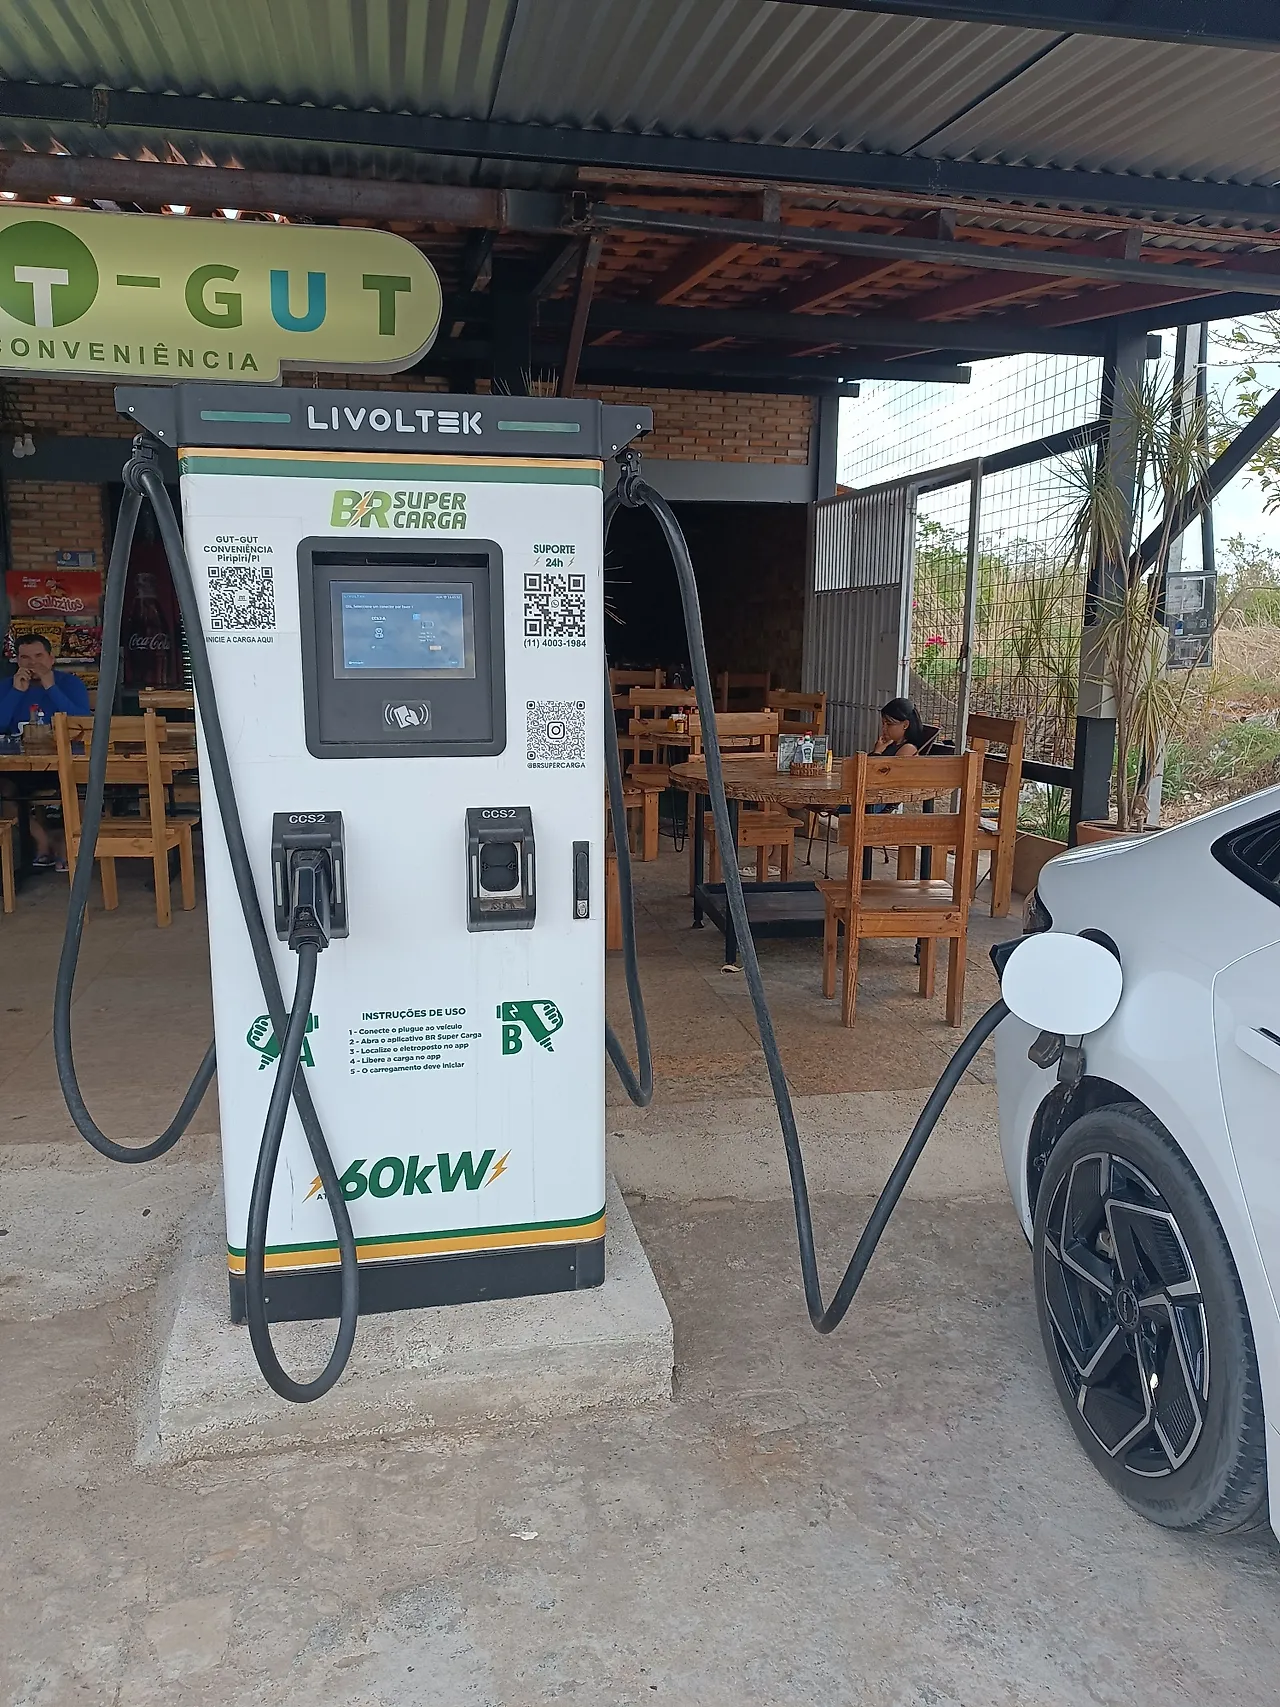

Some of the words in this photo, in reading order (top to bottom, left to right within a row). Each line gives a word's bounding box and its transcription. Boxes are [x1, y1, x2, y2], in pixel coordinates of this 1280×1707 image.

[0, 337, 259, 371] ONVENIÊNCIA
[307, 405, 484, 435] LIVOLTEK
[393, 490, 467, 511] SUPER
[330, 489, 393, 530] BR
[392, 511, 468, 530] CARGA
[215, 535, 259, 544] GUT-GUT
[203, 544, 274, 554] CONVENIÊNCIA
[533, 544, 576, 555] SUPORTE
[217, 553, 260, 564] Piripiri/PI
[545, 557, 564, 568] 24h
[523, 639, 540, 649] (11)
[542, 639, 587, 648] 4003-1984
[288, 813, 327, 824] CCS2
[481, 808, 517, 819] CCS2
[362, 1008, 427, 1020] INSTRUÇÕES
[429, 1008, 443, 1017] DE
[445, 1007, 467, 1016] USO
[359, 1027, 390, 1035] Conecte
[398, 1025, 424, 1034] plugue
[436, 1023, 463, 1031] veículo
[361, 1037, 380, 1045] Abra
[387, 1035, 424, 1043] aplicativo
[437, 1033, 459, 1041] Super
[460, 1032, 482, 1040] Carga
[502, 1024, 523, 1055] B
[361, 1046, 392, 1054] Localize
[399, 1043, 443, 1052] eletroposto
[454, 1042, 470, 1050] app
[361, 1056, 386, 1064] Libere
[393, 1055, 415, 1063] carga
[426, 1053, 441, 1061] app
[370, 1064, 422, 1074] carregamento
[338, 1149, 497, 1201] 60kW
